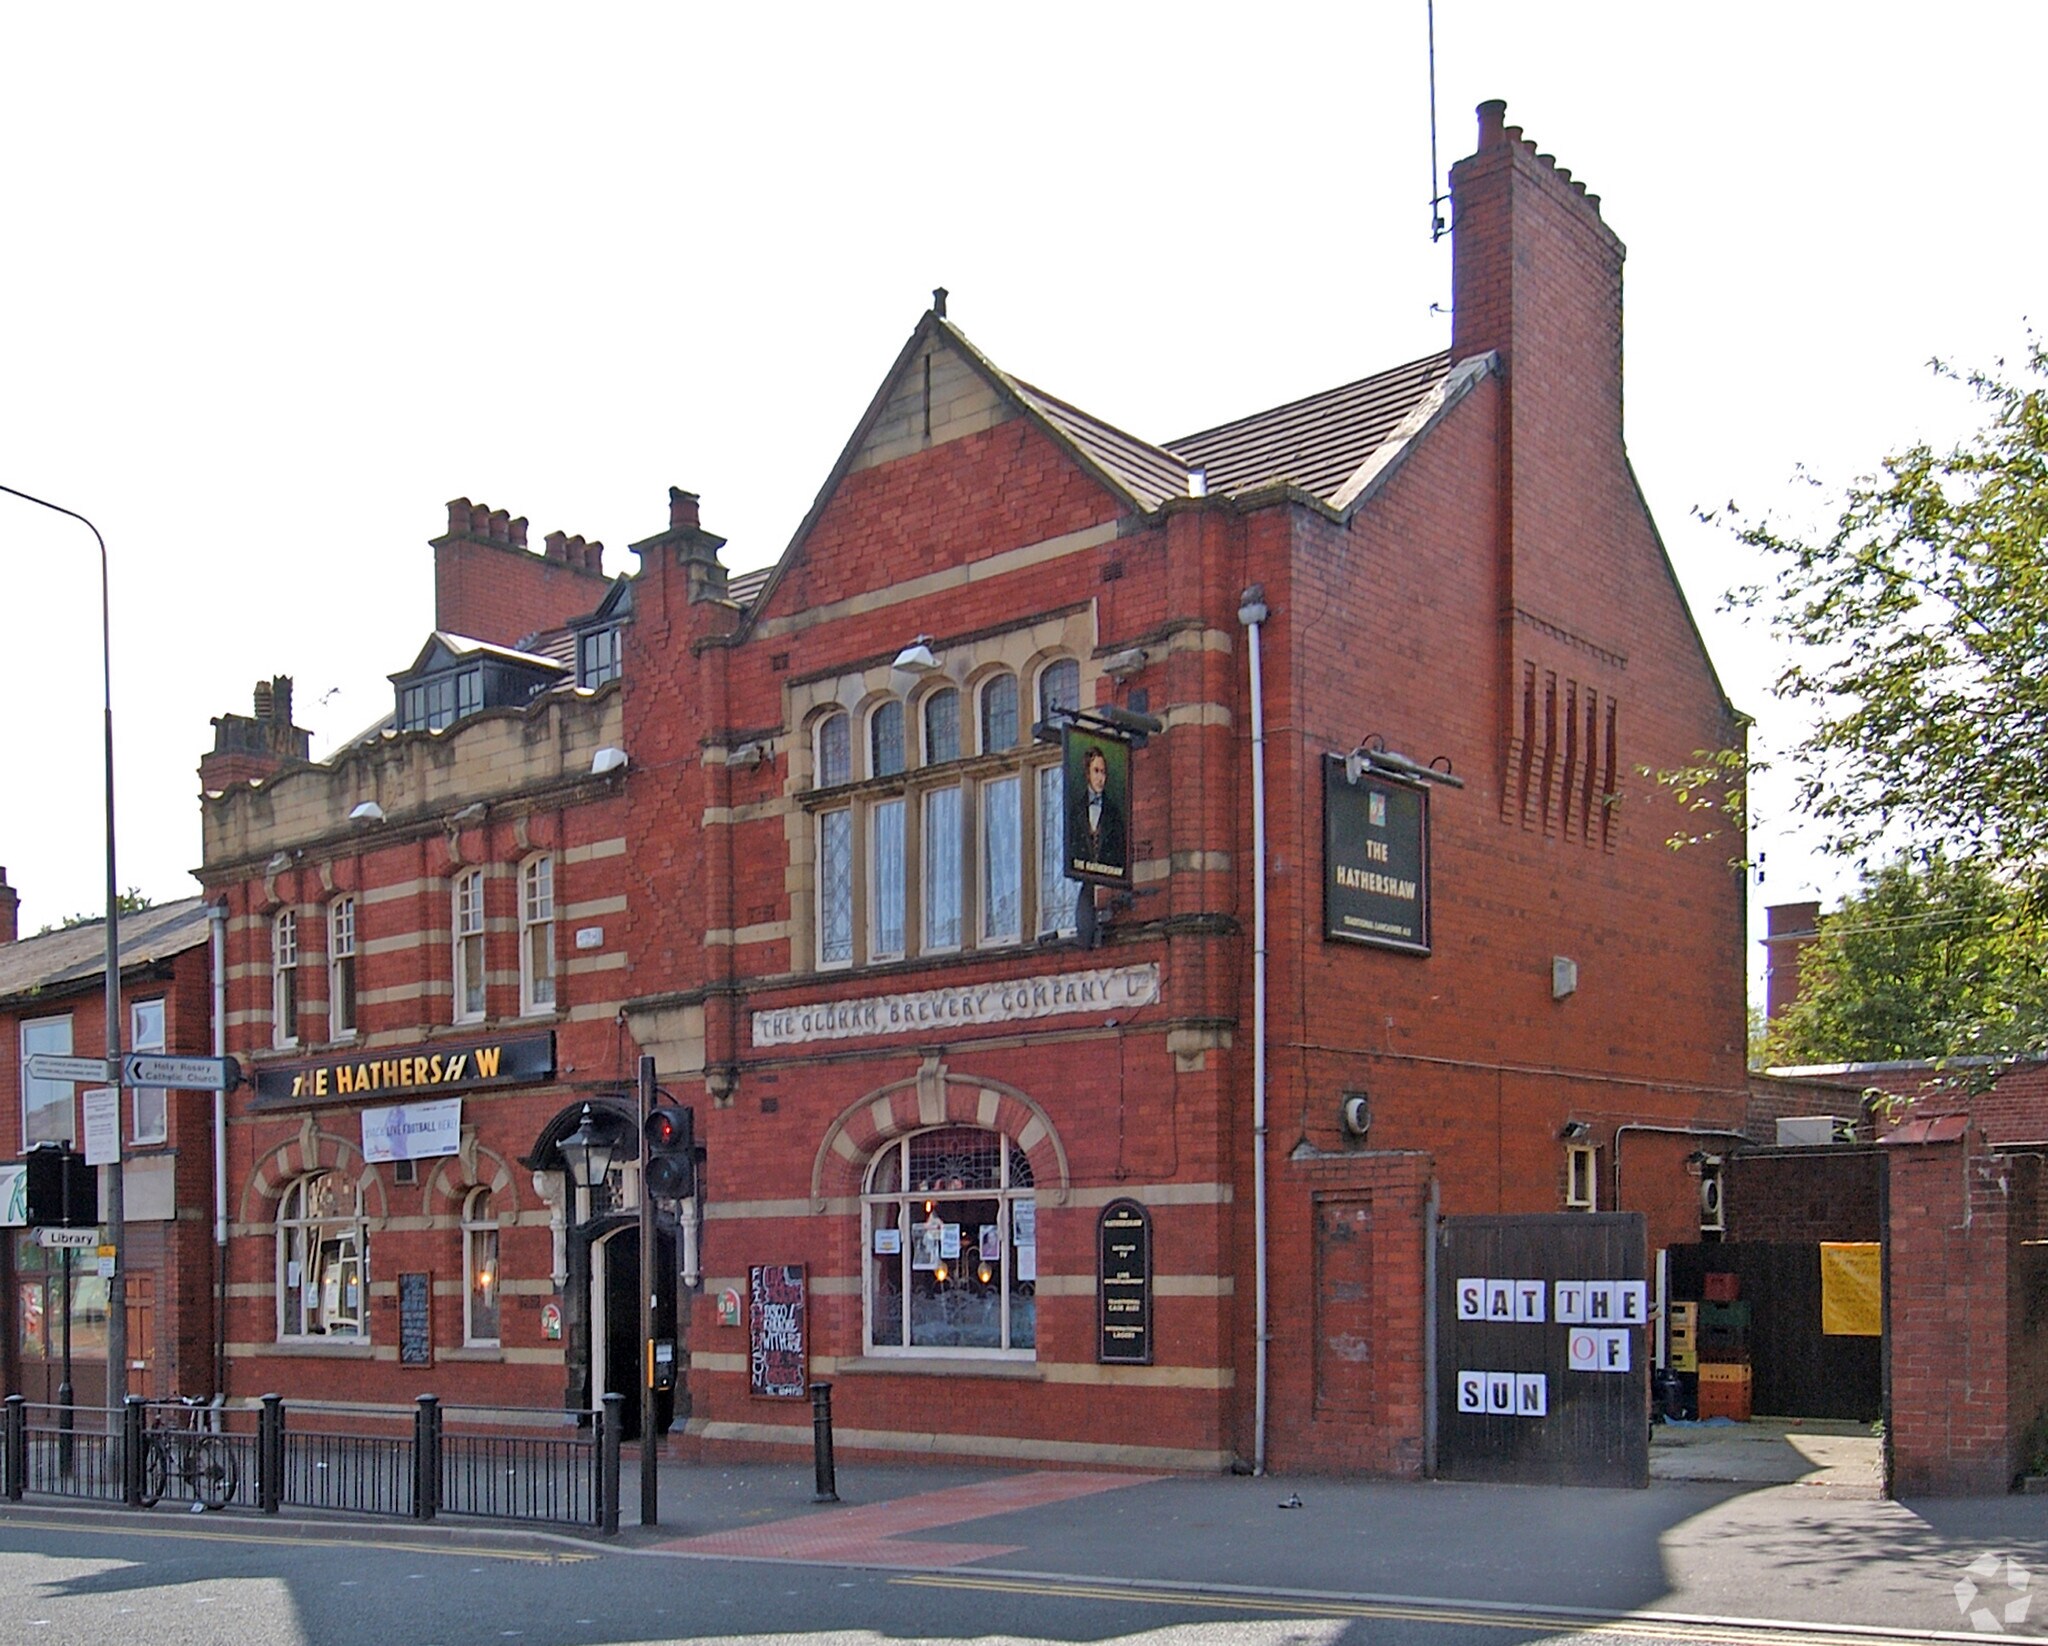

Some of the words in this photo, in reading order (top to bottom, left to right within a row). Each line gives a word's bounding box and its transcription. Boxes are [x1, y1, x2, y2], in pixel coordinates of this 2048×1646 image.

[1366, 839, 1389, 862] THE
[1336, 865, 1416, 900] HATHERSHAW
[762, 1015, 795, 1038] THE
[801, 1006, 878, 1032] OLDHAM
[890, 990, 990, 1023] BREWERY
[1001, 978, 1112, 1011] COMPANY
[145, 1071, 183, 1082] Catholic
[187, 1073, 219, 1083] Church
[153, 1061, 174, 1074] Holy
[180, 1063, 212, 1076] Rosary
[386, 1123, 400, 1136] LIVE
[402, 1121, 436, 1136] FOOTBALL
[51, 1233, 93, 1245] Library
[1463, 1288, 1536, 1317] SAT
[1560, 1290, 1636, 1319] THE
[1573, 1335, 1620, 1366] OF
[1464, 1380, 1538, 1411] SUN
